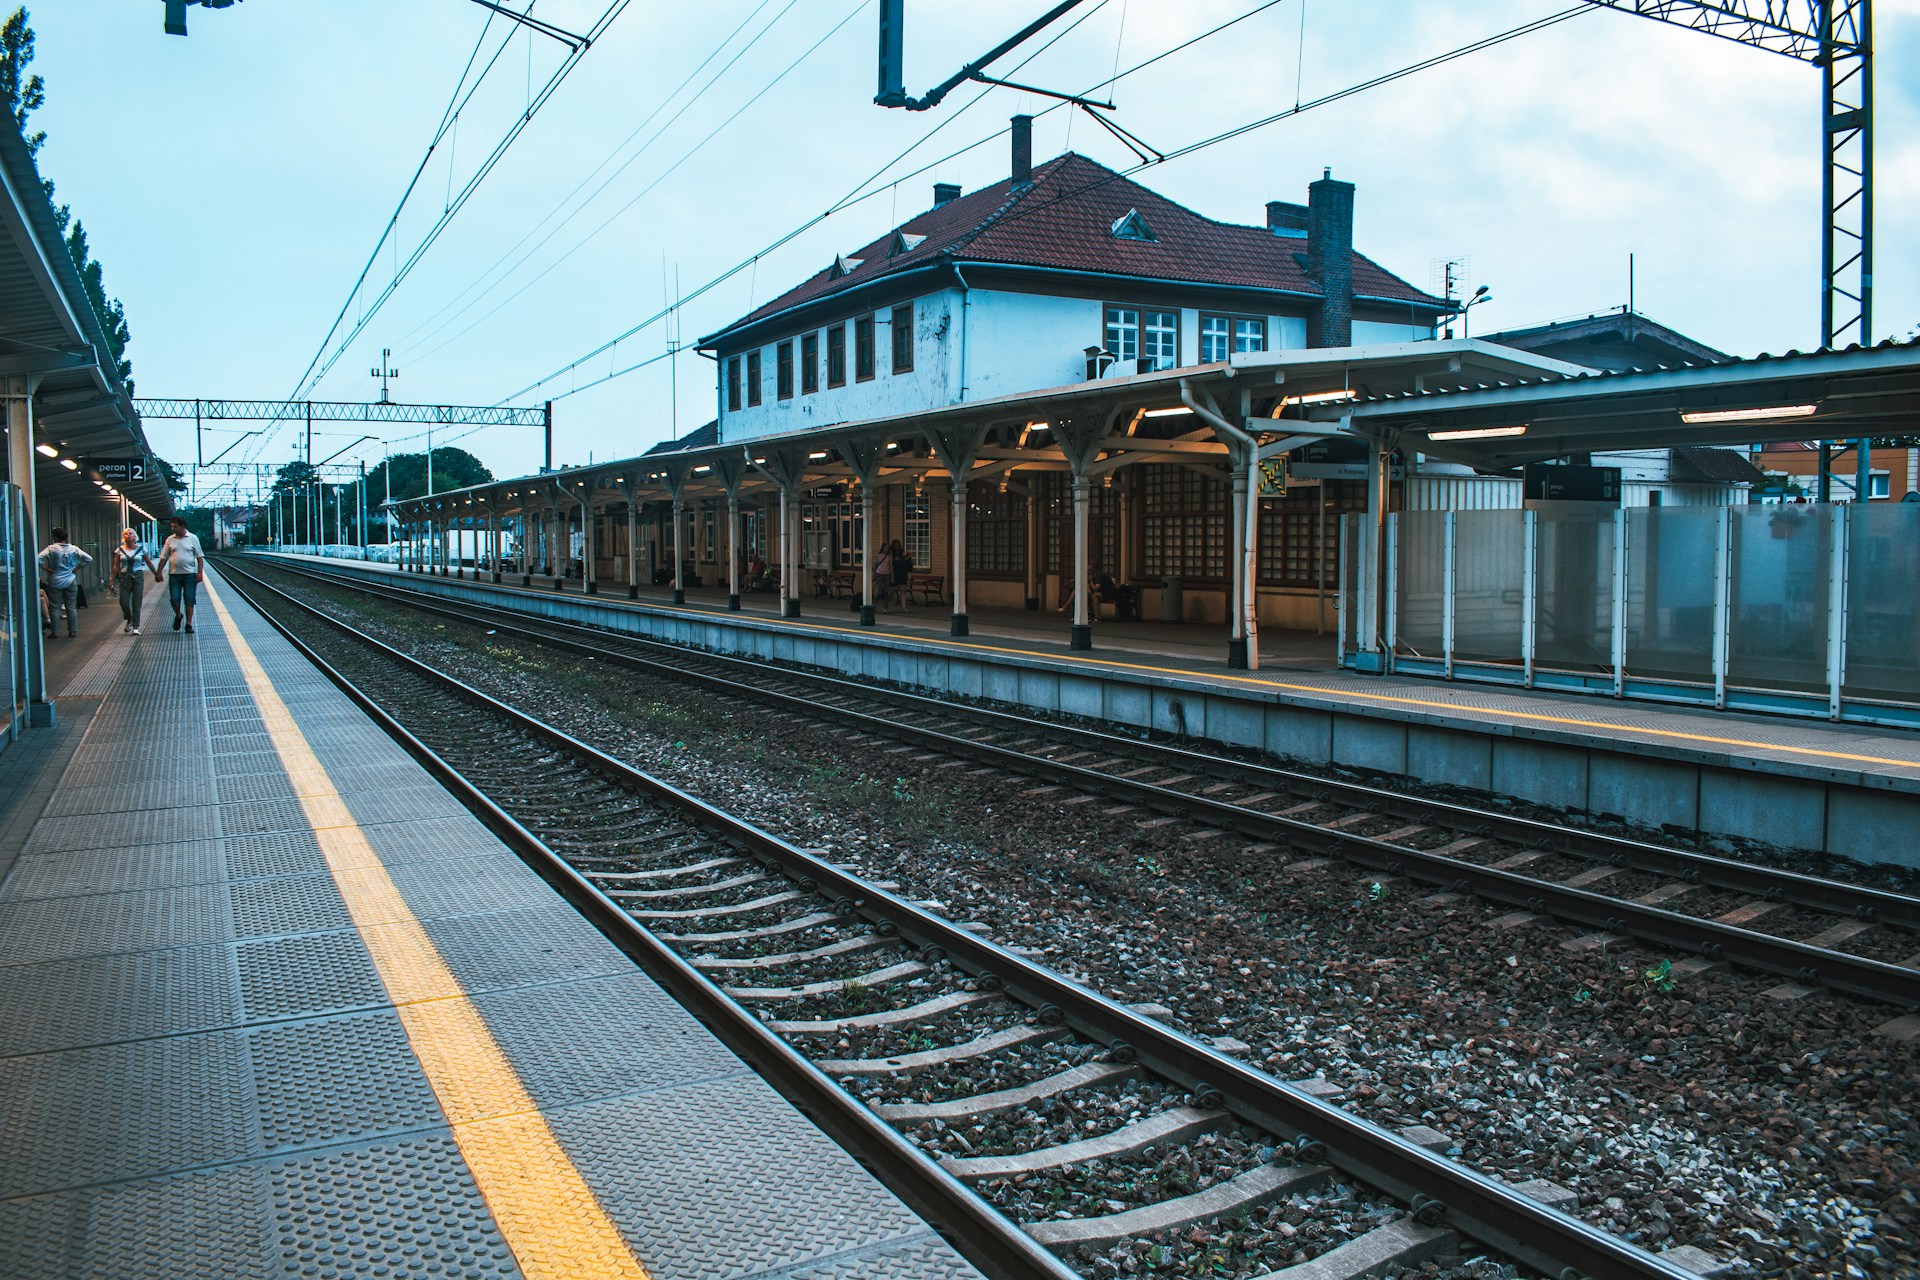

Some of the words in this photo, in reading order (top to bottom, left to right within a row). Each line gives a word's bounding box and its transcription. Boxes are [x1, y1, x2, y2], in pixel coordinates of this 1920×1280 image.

[1309, 447, 1328, 455] peron
[99, 464, 126, 473] peron
[132, 465, 143, 479] 2
